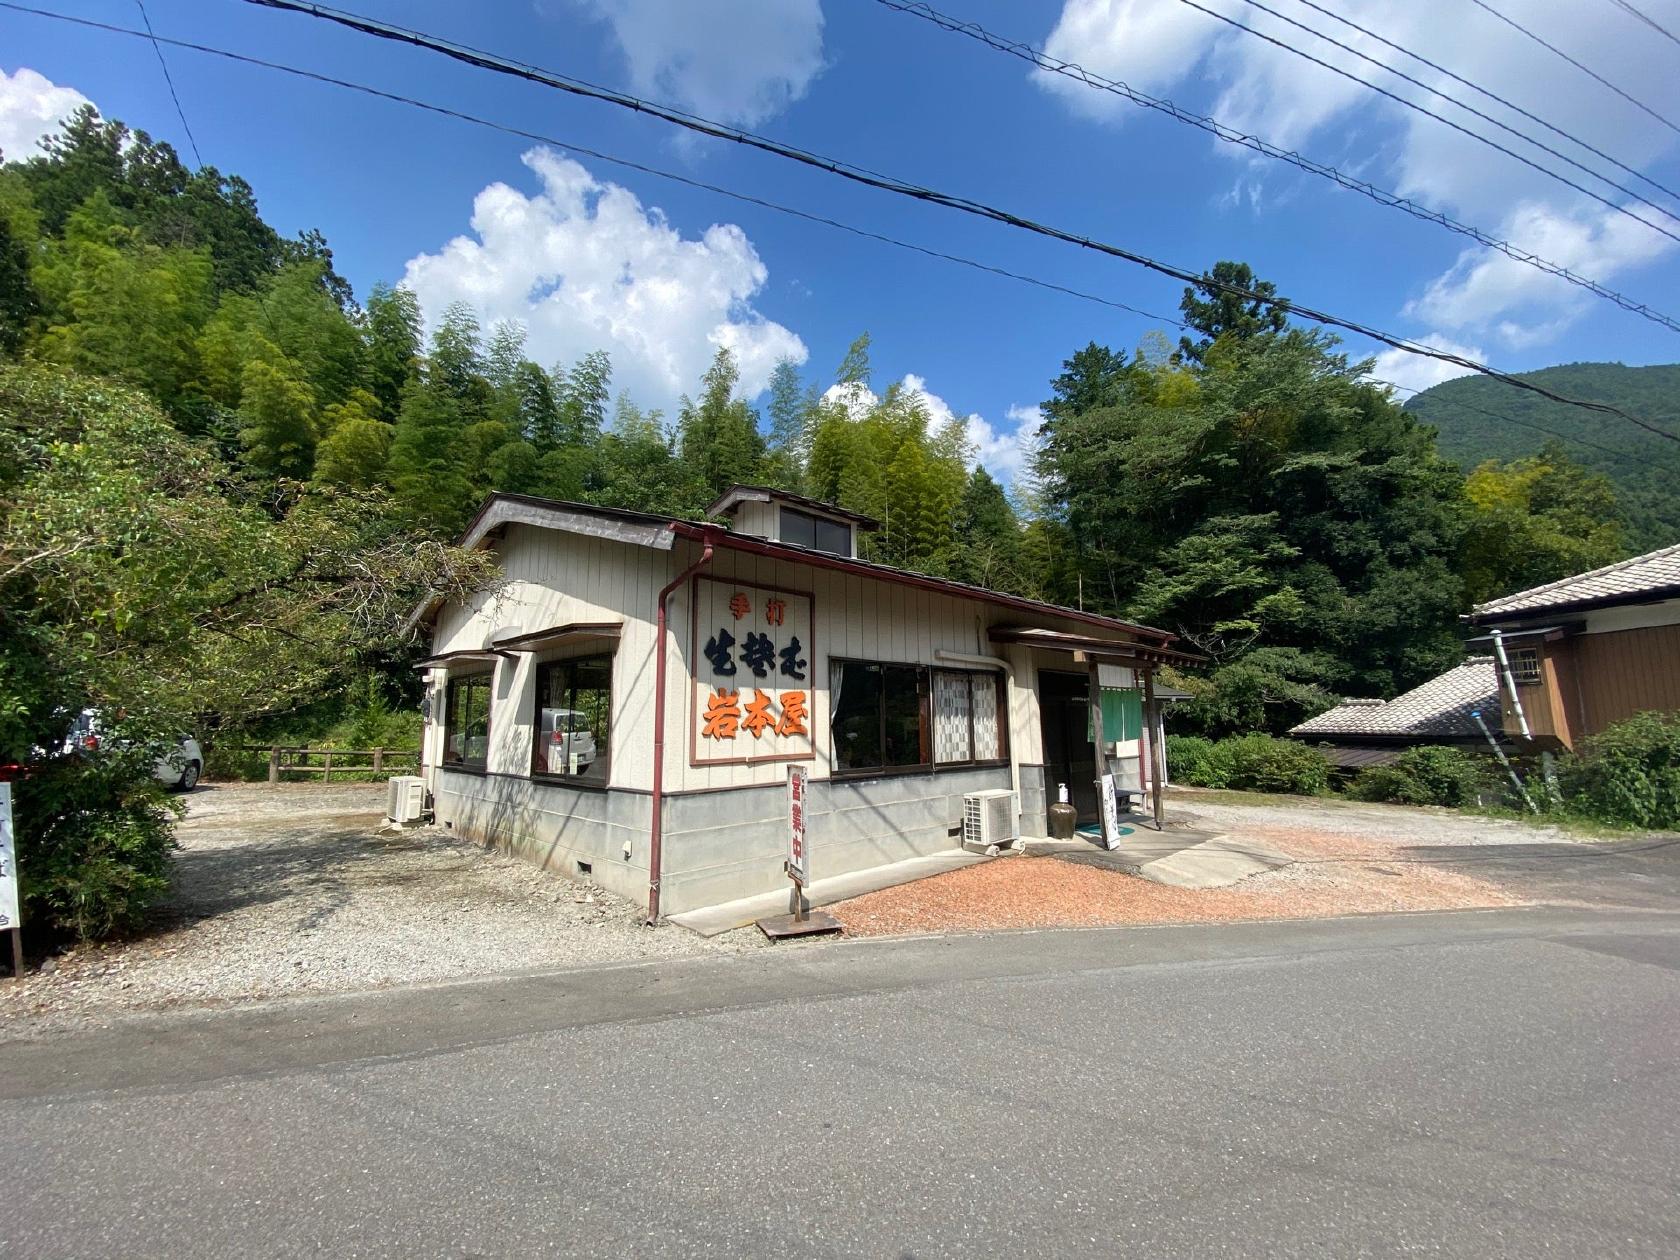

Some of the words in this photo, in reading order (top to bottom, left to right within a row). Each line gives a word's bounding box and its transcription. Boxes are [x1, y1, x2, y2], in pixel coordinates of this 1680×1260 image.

[702, 688, 808, 742] 岩本屋
[792, 773, 802, 865] 営業中
